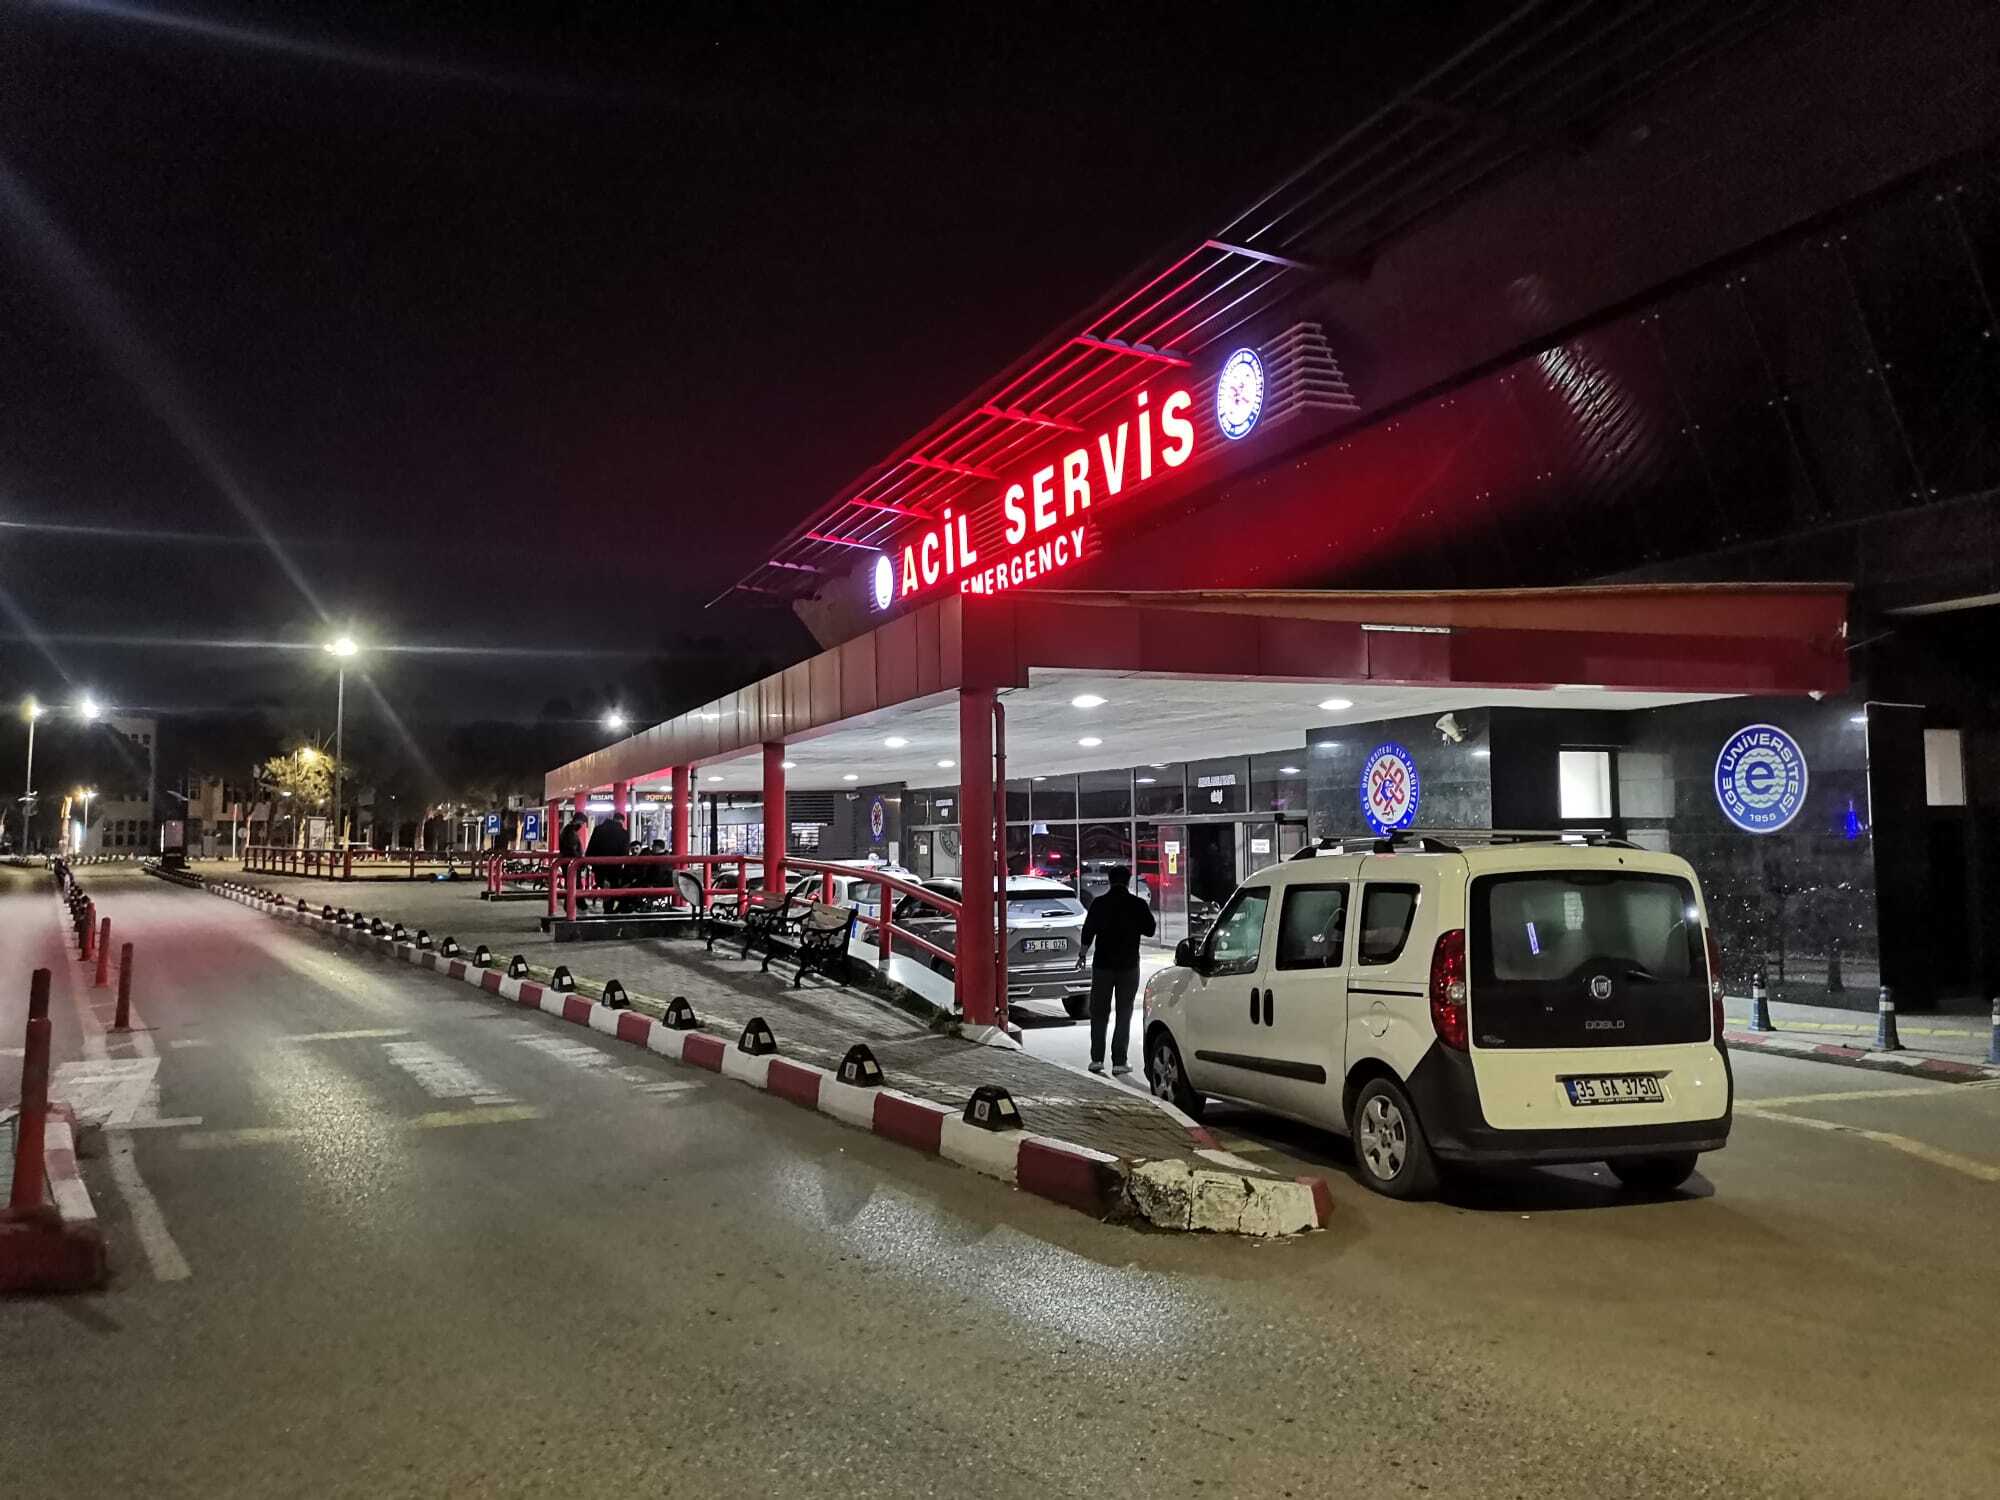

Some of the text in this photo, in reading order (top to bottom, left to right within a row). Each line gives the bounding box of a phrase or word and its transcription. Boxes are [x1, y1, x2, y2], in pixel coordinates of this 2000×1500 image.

[902, 508, 977, 596] ACİL
[1004, 390, 1194, 545] SERVİS
[1722, 733, 1799, 816] EGE ÜNİVERSİTESİ
[488, 815, 497, 827] P
[526, 815, 536, 831] P
[1575, 1077, 1657, 1098] 35 GA 3750
